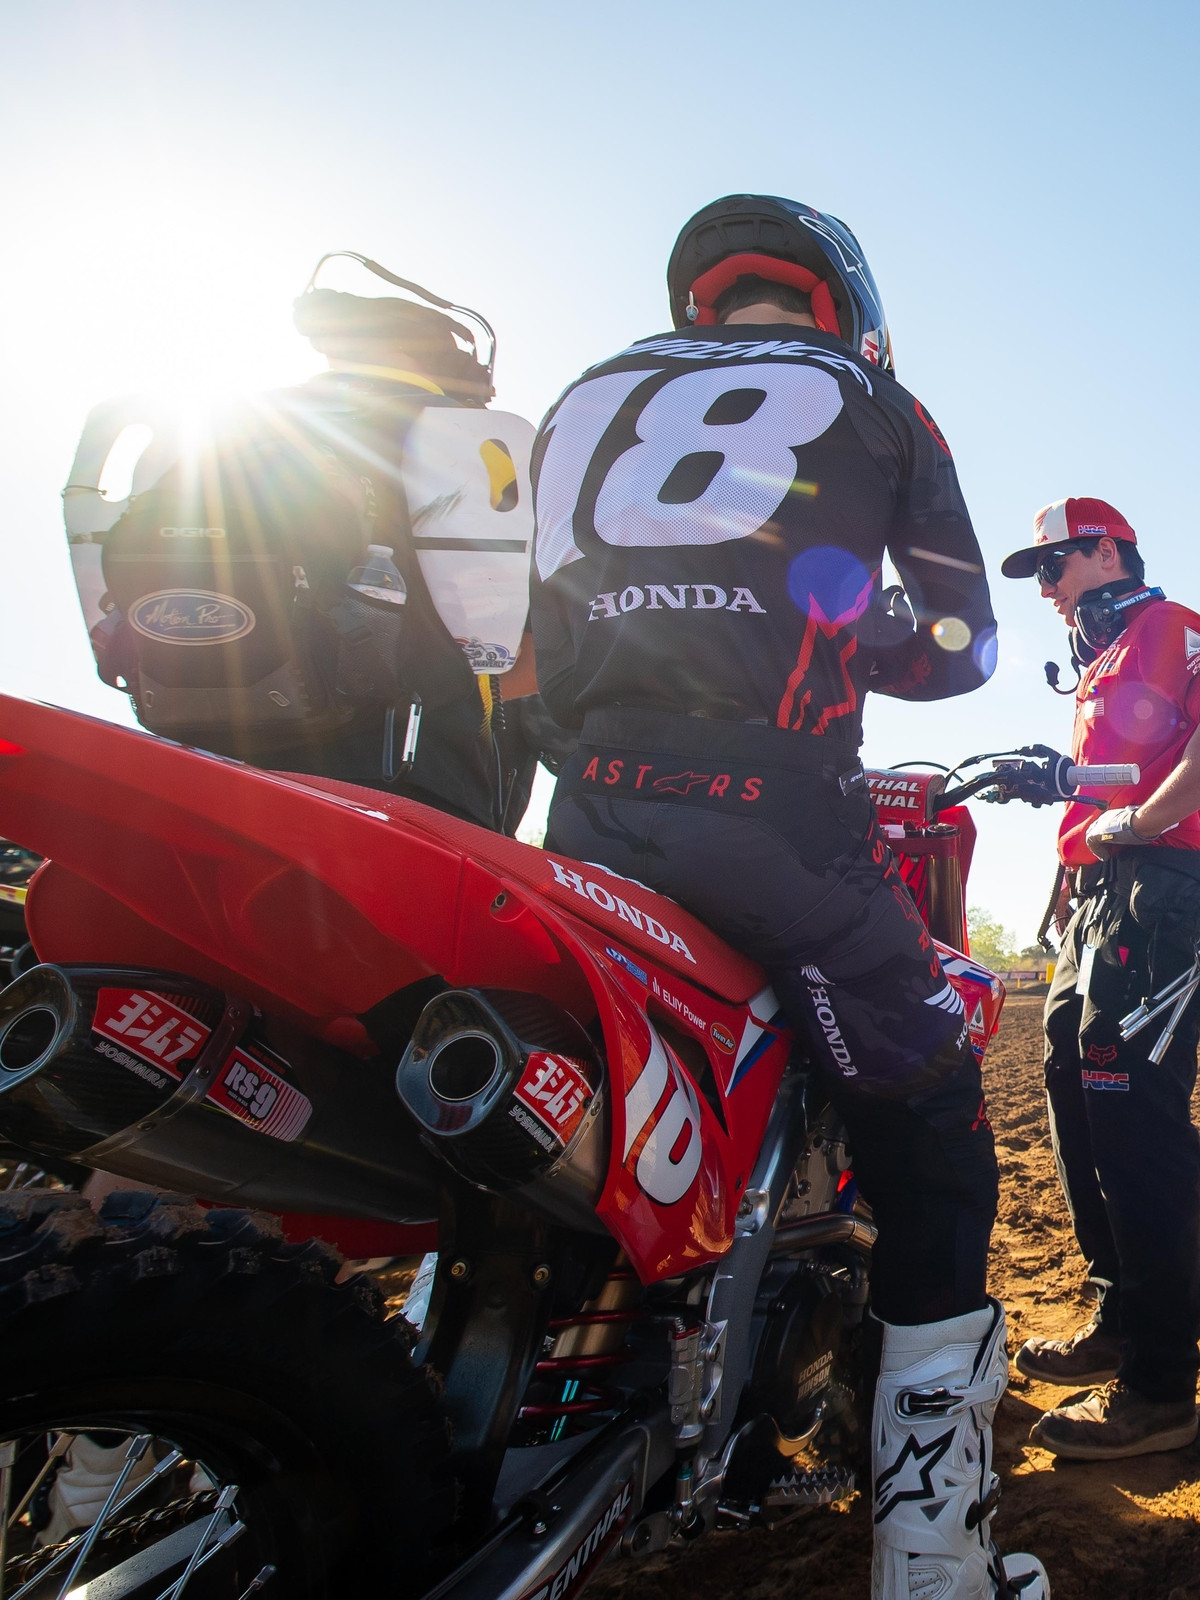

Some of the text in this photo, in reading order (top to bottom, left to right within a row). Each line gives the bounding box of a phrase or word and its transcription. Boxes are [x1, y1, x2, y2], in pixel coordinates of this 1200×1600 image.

[535, 363, 844, 582] 18
[159, 527, 227, 538] OGIO
[1078, 525, 1107, 534] HRC
[146, 600, 235, 626] Motion Pro
[588, 585, 767, 621] HONDA
[1114, 591, 1151, 611] CHRISTIEN
[546, 858, 697, 965] HONDA
[104, 993, 202, 1063] ヨシムラ
[683, 1004, 707, 1031] Power
[807, 986, 859, 1077] HONDA
[712, 1027, 735, 1049] Twin Air
[94, 1040, 168, 1089] YOSHIMURA
[1081, 1069, 1130, 1091] HRC
[223, 1061, 278, 1119] RS-9
[523, 1056, 584, 1124] ヨシムラ
[508, 1104, 557, 1153] YOSHIMURA
[798, 1350, 833, 1384] HONDA
